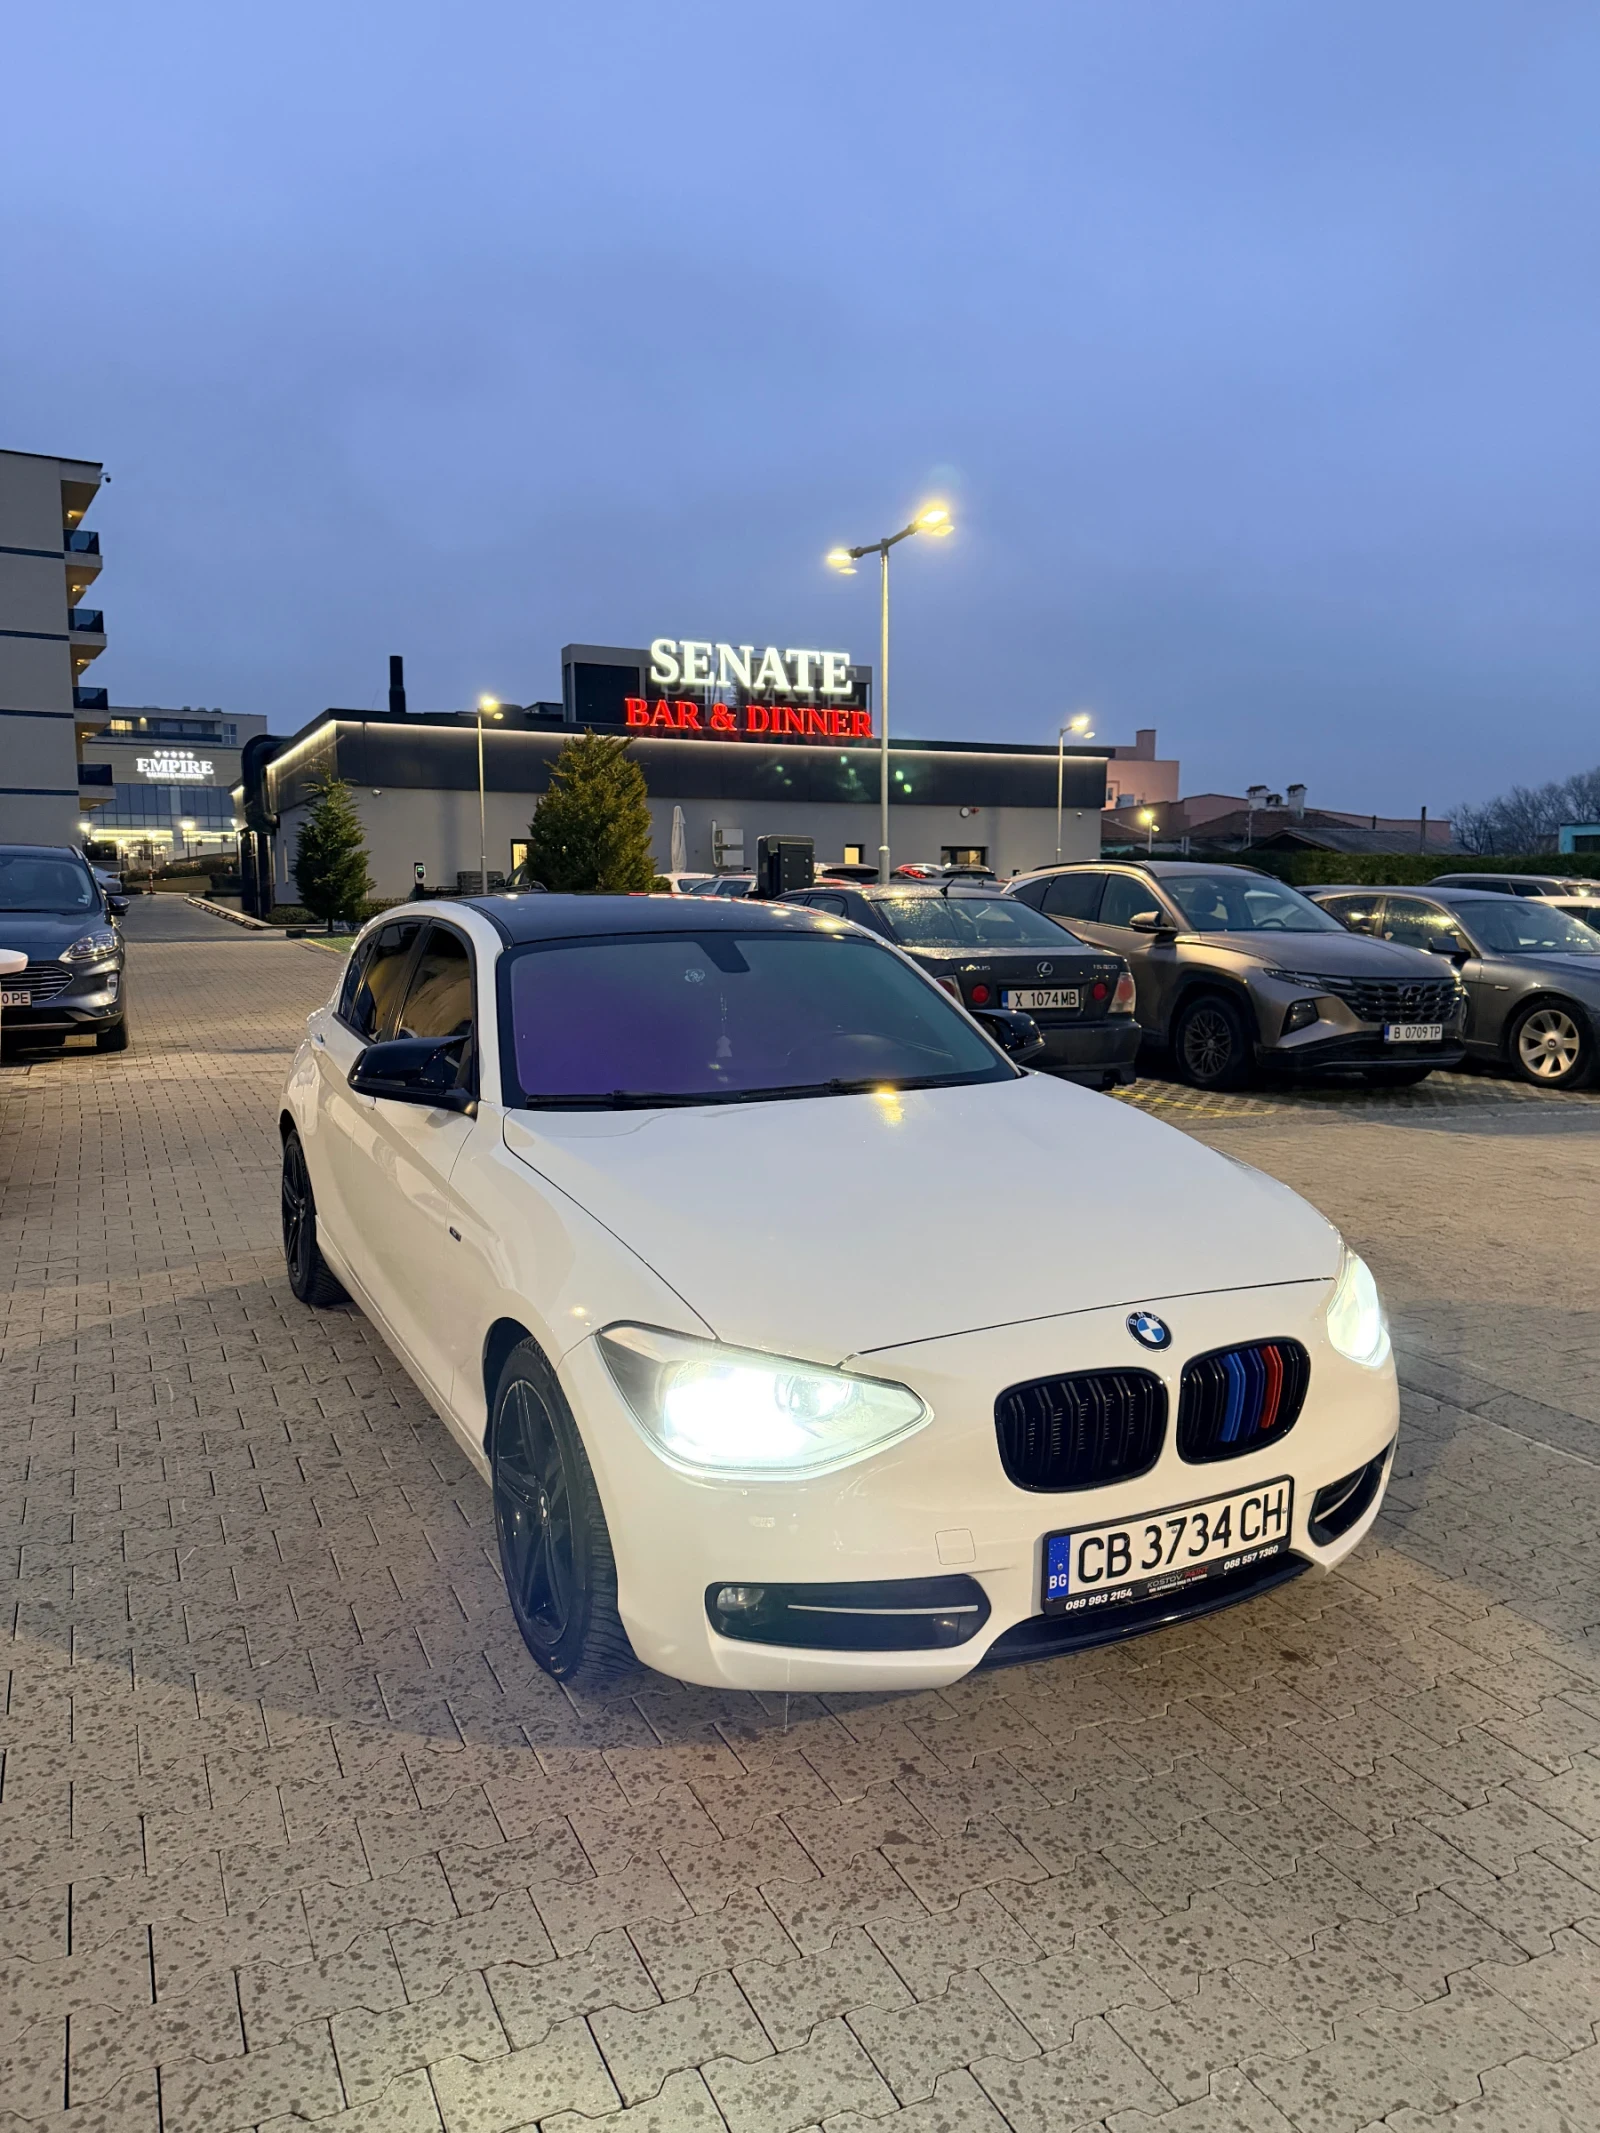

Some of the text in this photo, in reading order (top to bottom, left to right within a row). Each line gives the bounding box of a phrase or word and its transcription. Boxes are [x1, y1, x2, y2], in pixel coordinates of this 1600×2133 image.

[650, 638, 853, 694] SENATE
[624, 697, 874, 738] BAR & DINNER
[136, 758, 214, 775] EMPIRE
[12, 993, 29, 1004] PE
[1015, 991, 1077, 1007] X 1074 MB
[1394, 1026, 1441, 1039] B 0709 TP
[1129, 1311, 1159, 1326] BMW
[1078, 1488, 1284, 1584] CB 3734 CH
[1223, 1545, 1279, 1571] 088 557 7360
[1049, 1572, 1068, 1590] BG
[1147, 1573, 1183, 1588] KOSTOV
[1184, 1565, 1209, 1578] PAINT
[1065, 1588, 1133, 1611] 089 993 2154
